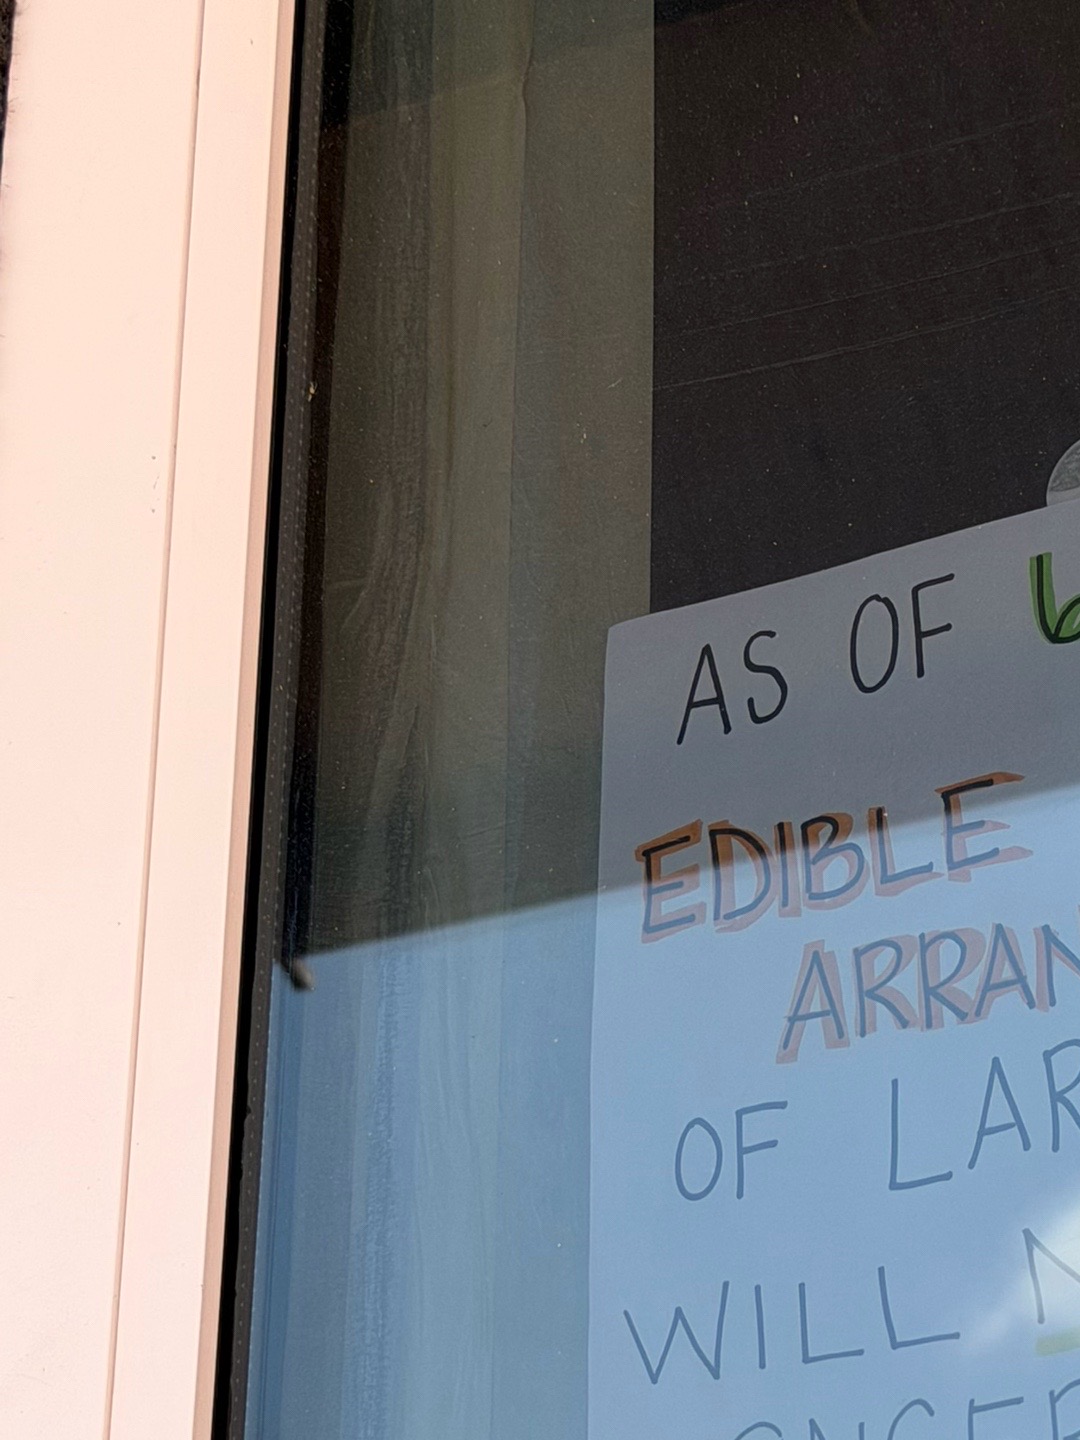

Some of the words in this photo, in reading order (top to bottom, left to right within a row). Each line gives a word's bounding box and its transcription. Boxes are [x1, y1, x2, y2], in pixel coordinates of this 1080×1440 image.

[677, 629, 788, 745] AS
[849, 572, 955, 693] OF
[635, 772, 1034, 943] EDIBLE
[674, 1100, 787, 1200] OF
[623, 1265, 961, 1385] WILL
